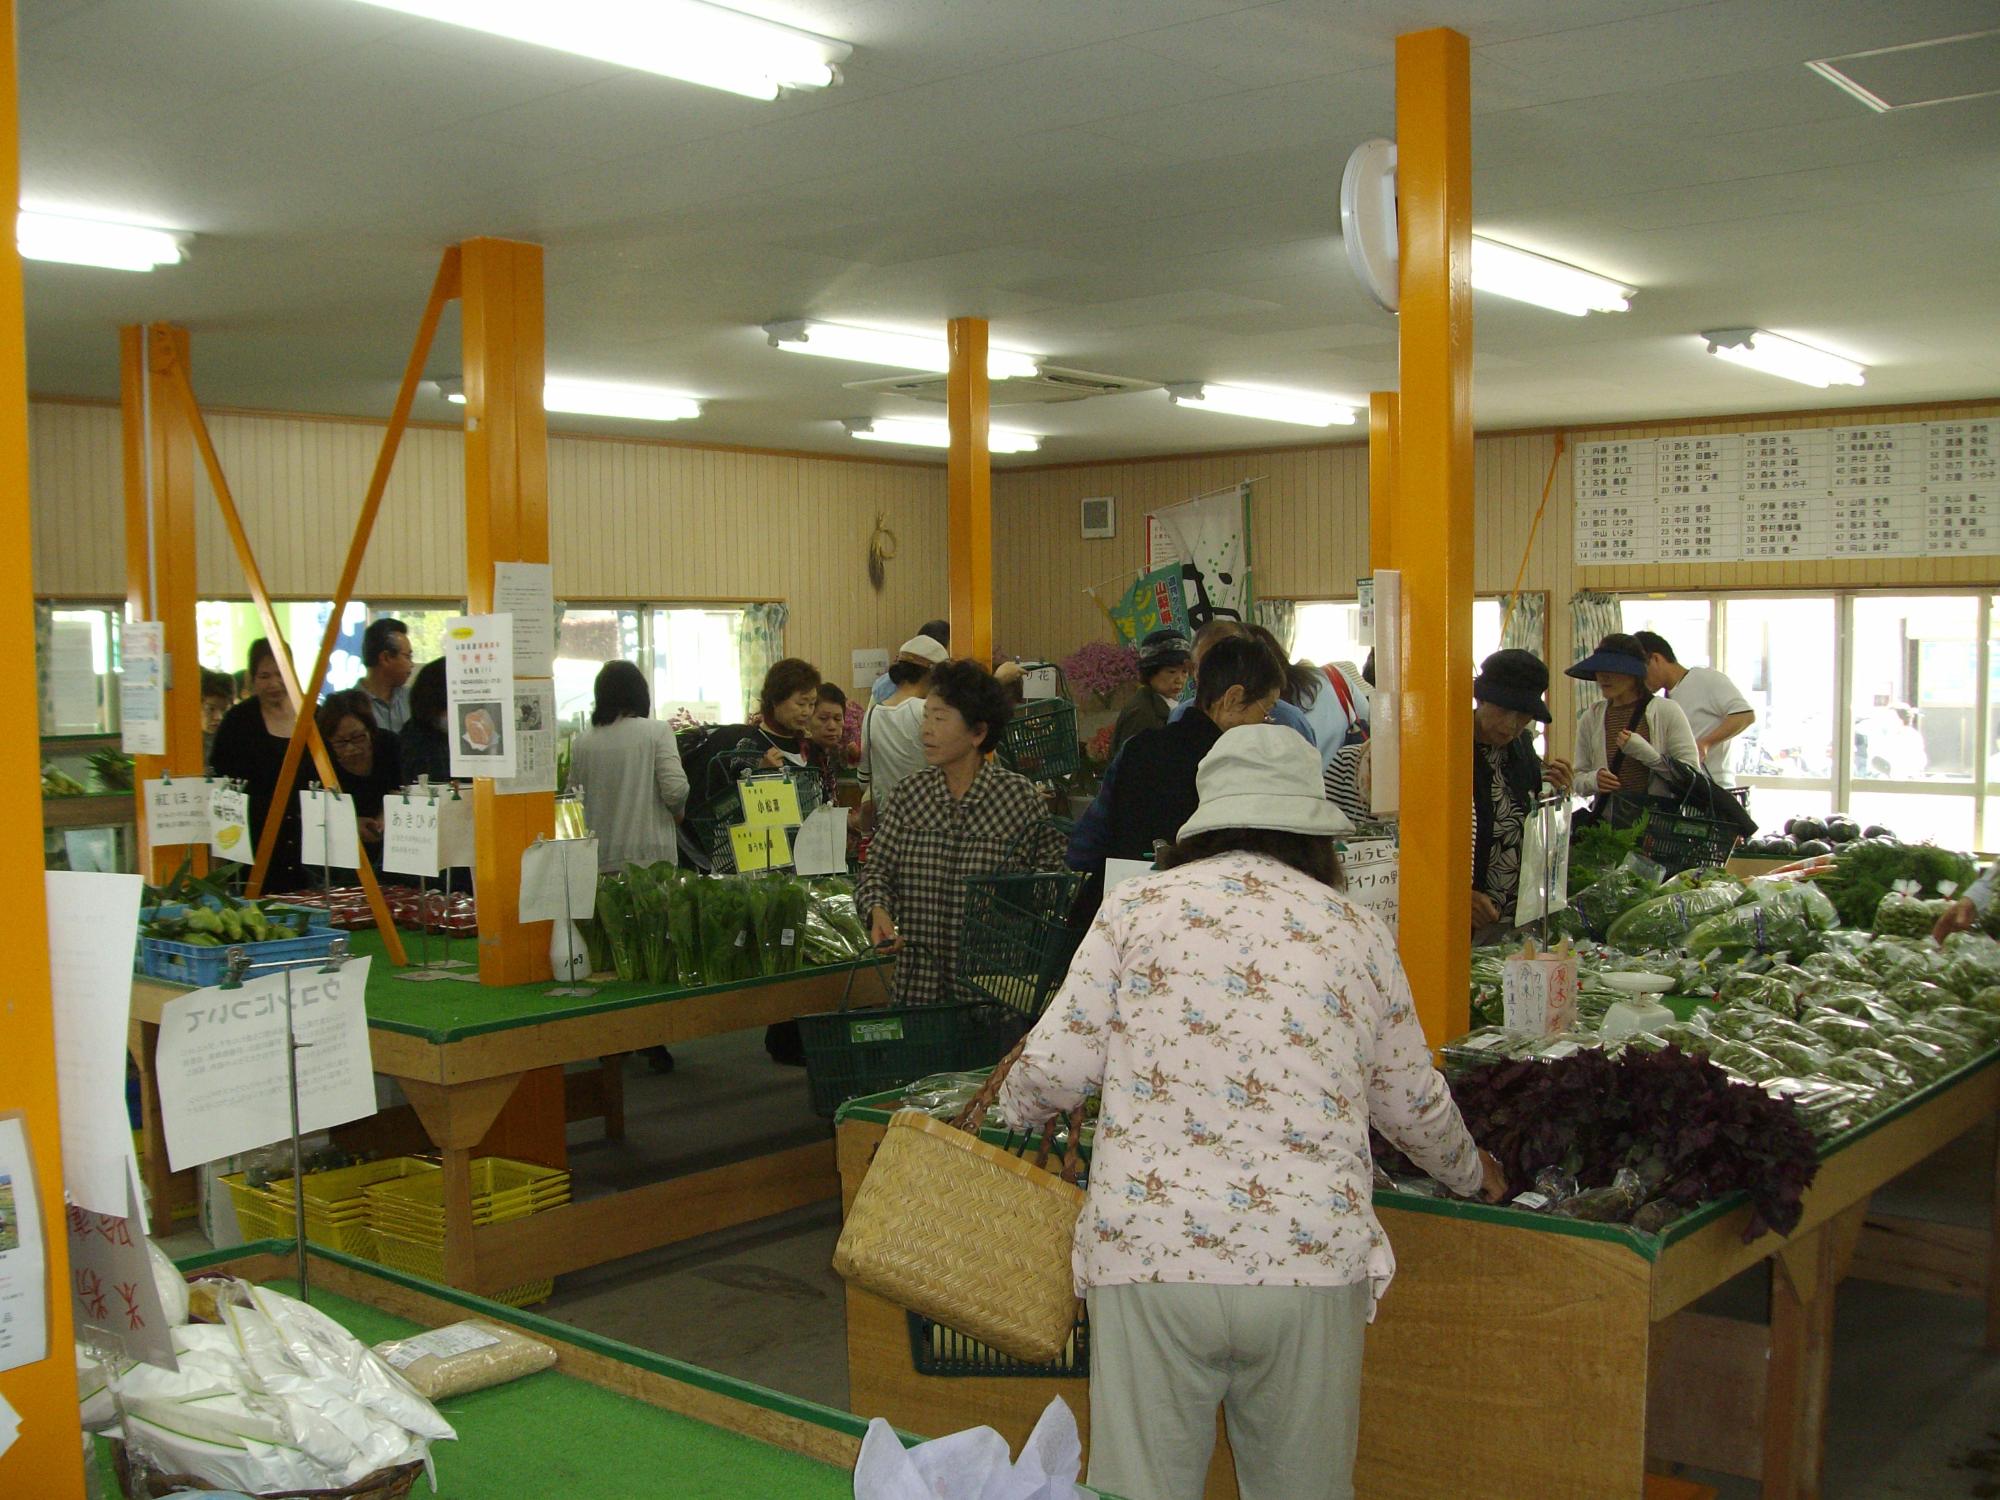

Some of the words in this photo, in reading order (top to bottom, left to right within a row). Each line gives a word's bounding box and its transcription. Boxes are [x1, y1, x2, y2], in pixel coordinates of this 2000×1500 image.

[155, 792, 210, 806] 紅ほっ
[757, 797, 781, 814] 小松菜
[1336, 844, 1393, 865] コールラビ
